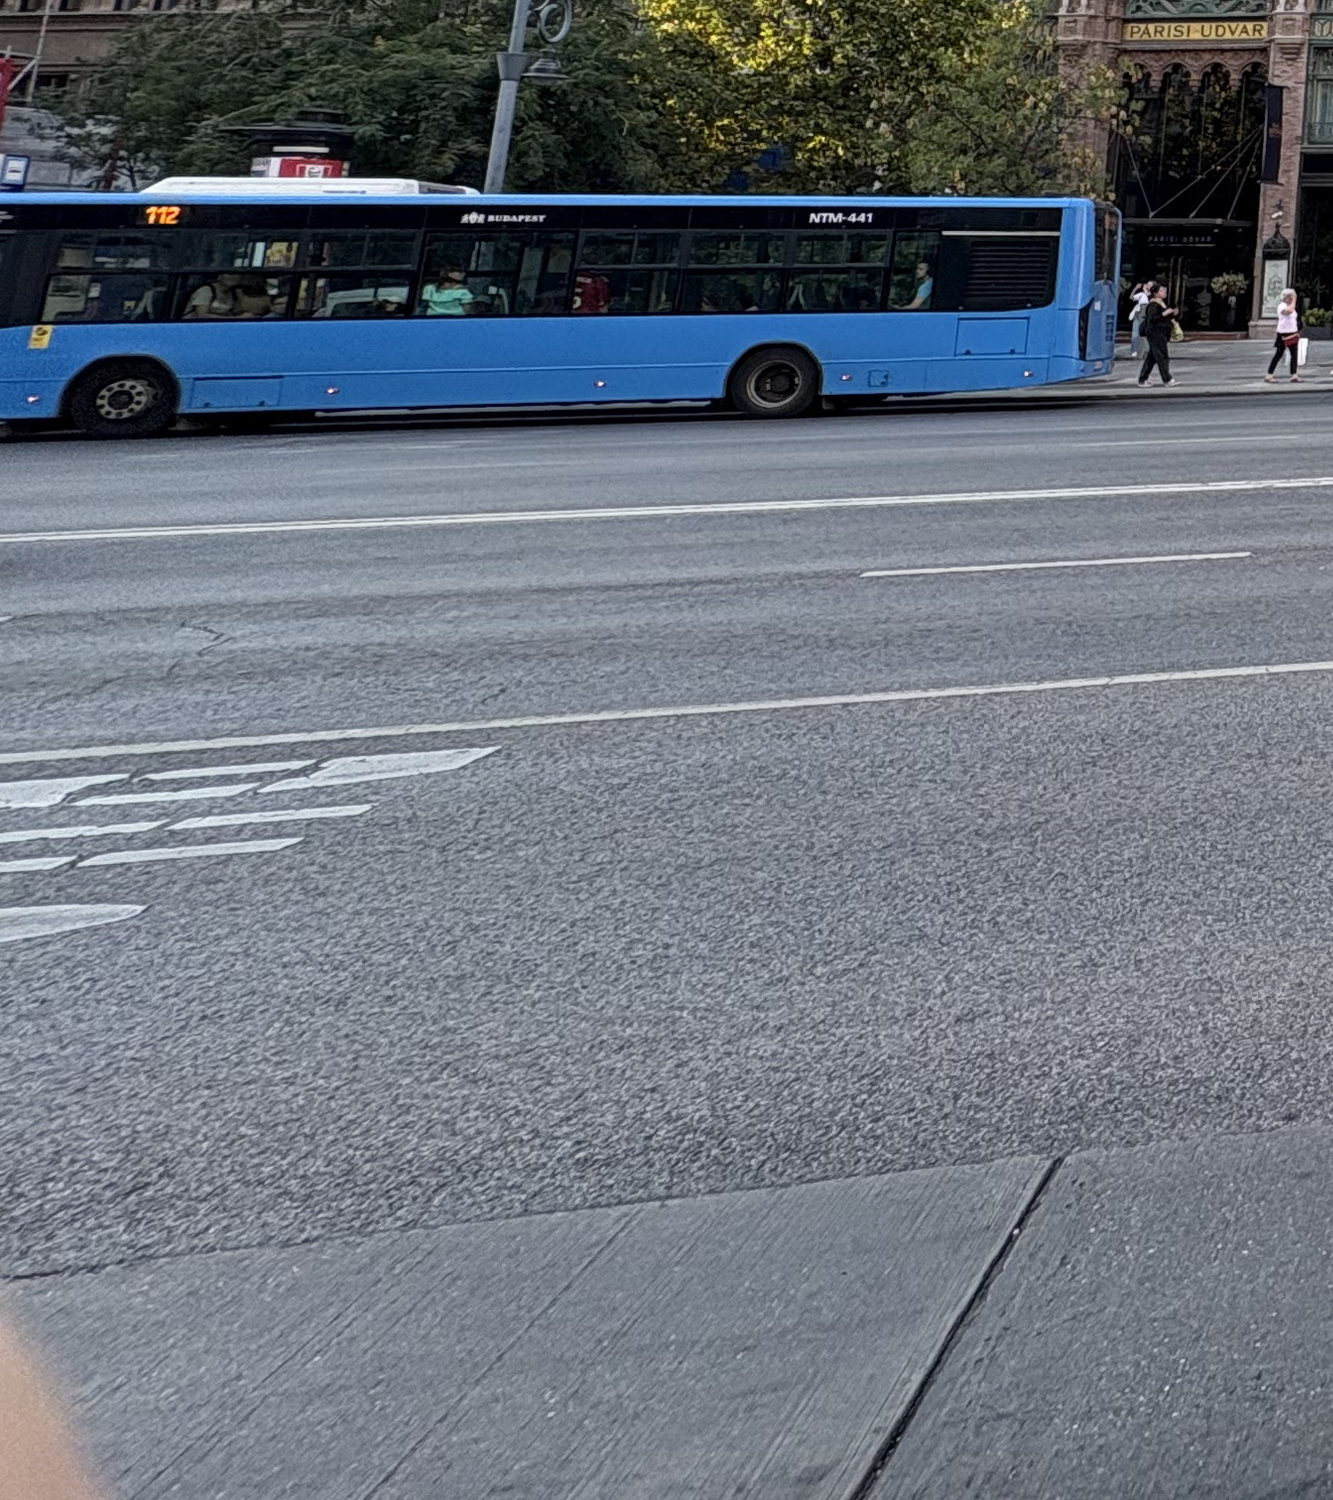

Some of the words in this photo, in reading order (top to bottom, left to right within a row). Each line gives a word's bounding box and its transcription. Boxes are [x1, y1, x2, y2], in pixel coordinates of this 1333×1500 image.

[1200, 23, 1264, 37] UDVAR
[145, 206, 182, 225] 112
[487, 214, 547, 223] BUDAPEST
[808, 212, 873, 224] NTM-441
